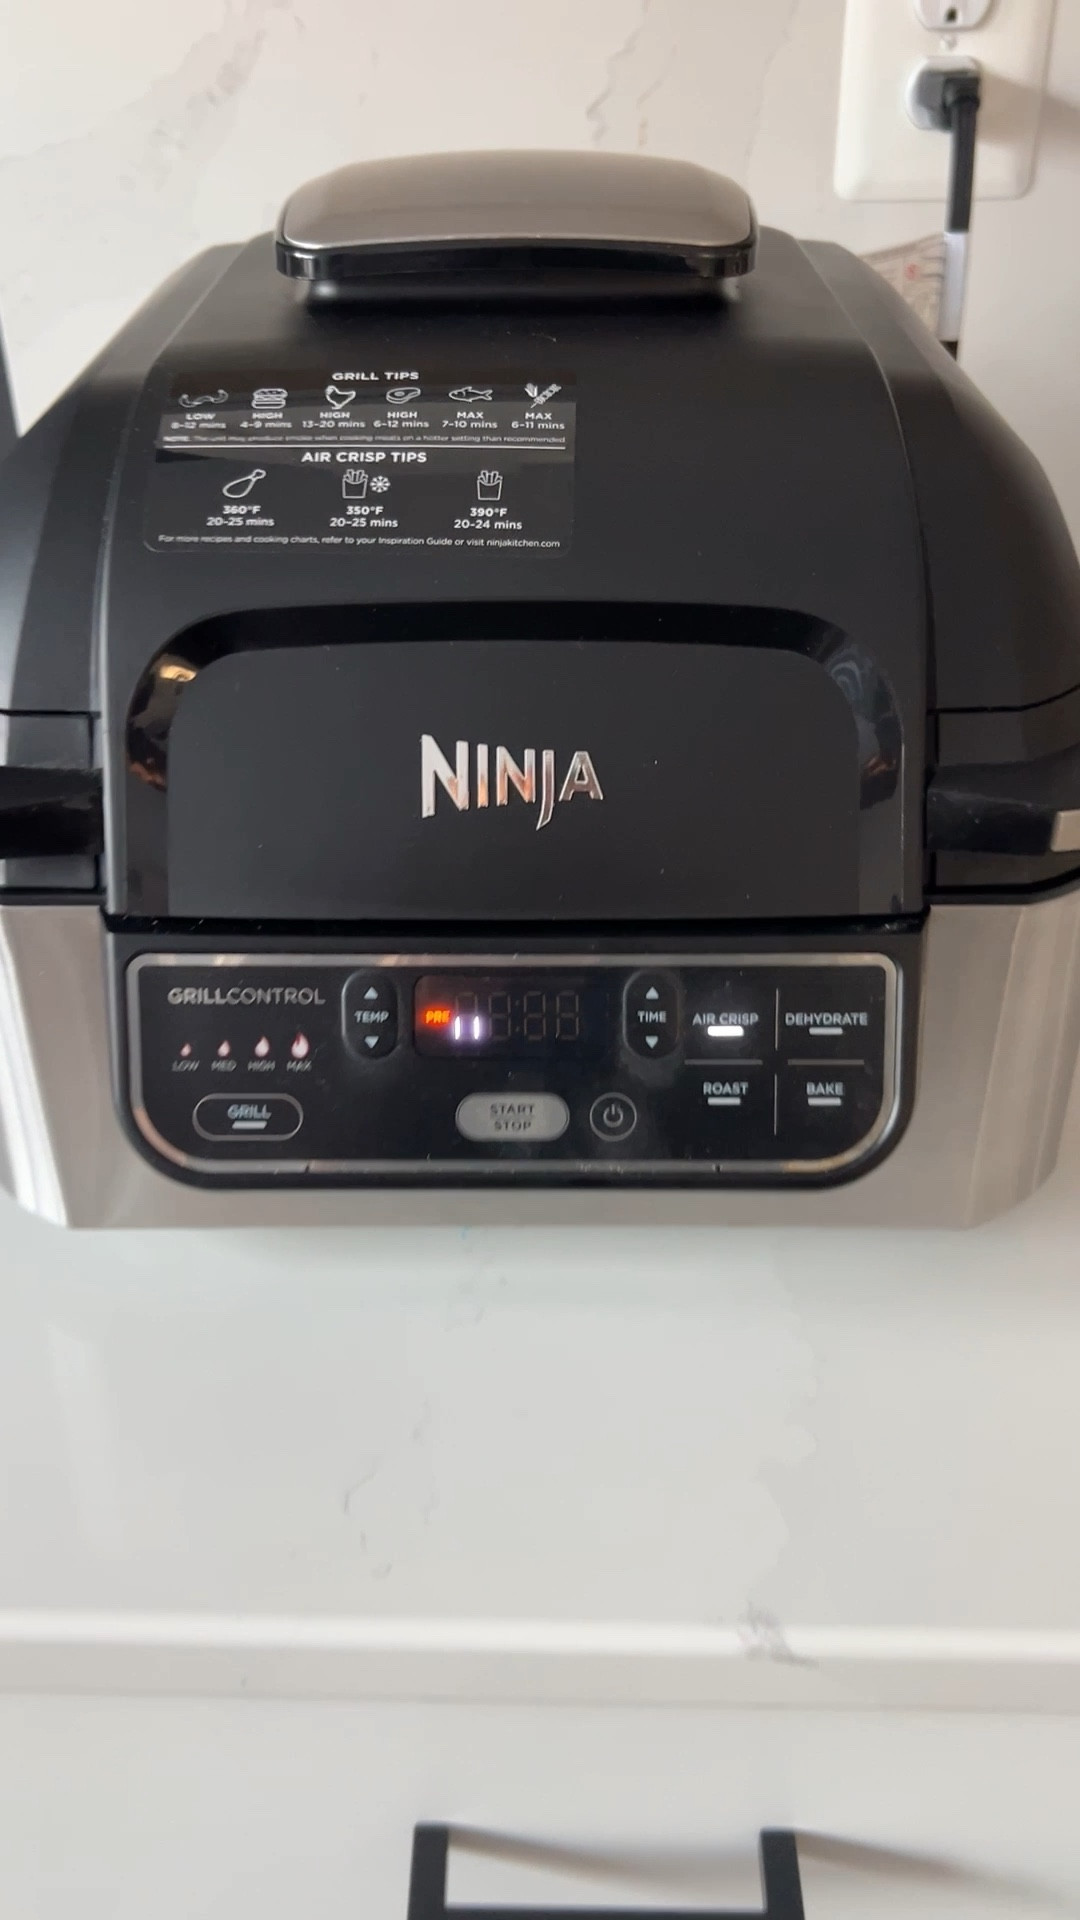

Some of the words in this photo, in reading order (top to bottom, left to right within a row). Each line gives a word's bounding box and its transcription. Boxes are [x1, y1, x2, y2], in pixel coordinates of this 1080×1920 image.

[332, 371, 378, 381] GRILL
[384, 371, 420, 381] TIPS
[185, 412, 217, 421] LOW
[251, 411, 284, 420] HIGH
[319, 411, 351, 420] HIGH
[386, 411, 418, 420] HIGH
[456, 411, 484, 420] MAX
[524, 412, 553, 421] MAX
[198, 421, 227, 430] mins
[264, 420, 293, 429] mins
[302, 420, 336, 429] 13-20
[337, 420, 366, 429] mins
[373, 420, 400, 429] 6-12
[401, 420, 430, 429] mins
[441, 420, 468, 429] 7-10
[470, 420, 498, 429] mins
[511, 421, 535, 430] 6-11
[537, 421, 566, 431] mins
[301, 451, 331, 463] AIR
[335, 451, 386, 463] CRISP
[390, 451, 428, 464] TIPS
[222, 505, 262, 515] 360°F
[345, 506, 384, 516] 350°F
[469, 507, 508, 518] 390°F
[206, 516, 244, 527] 20-25
[245, 517, 275, 527] mins
[329, 517, 367, 528] 20-25
[369, 517, 399, 528] mins
[453, 519, 491, 530] 20-24
[493, 519, 523, 530] mins
[158, 534, 174, 543] For
[175, 535, 199, 543] more
[200, 535, 233, 545] recipes
[234, 535, 252, 543] and
[253, 535, 289, 545] cooking
[289, 535, 320, 545] charts,
[321, 535, 343, 544] refer
[344, 536, 355, 544] to
[356, 537, 376, 546] your
[378, 536, 424, 546] Inspiration
[426, 537, 453, 546] Guide
[454, 538, 465, 546] or
[466, 538, 485, 547] visit
[486, 538, 561, 549] ninjakitchen.com
[421, 733, 604, 831] NINJA
[167, 986, 326, 1006] GRILLCONTROL
[354, 1009, 390, 1024] TEMP
[425, 1010, 451, 1024] PRE
[637, 1010, 668, 1023] TIME
[692, 1012, 718, 1026] AIR
[719, 1012, 759, 1026] CRISP
[784, 1012, 869, 1027] DEHYDRATE
[171, 1059, 200, 1073] LOW
[210, 1059, 238, 1073] MED
[247, 1059, 276, 1073] HIGH
[285, 1059, 313, 1073] MAX
[702, 1081, 749, 1096] ROAST
[805, 1081, 845, 1096] BAKE
[226, 1103, 272, 1120] GRILL
[490, 1102, 536, 1115] START
[494, 1120, 532, 1132] STOP
